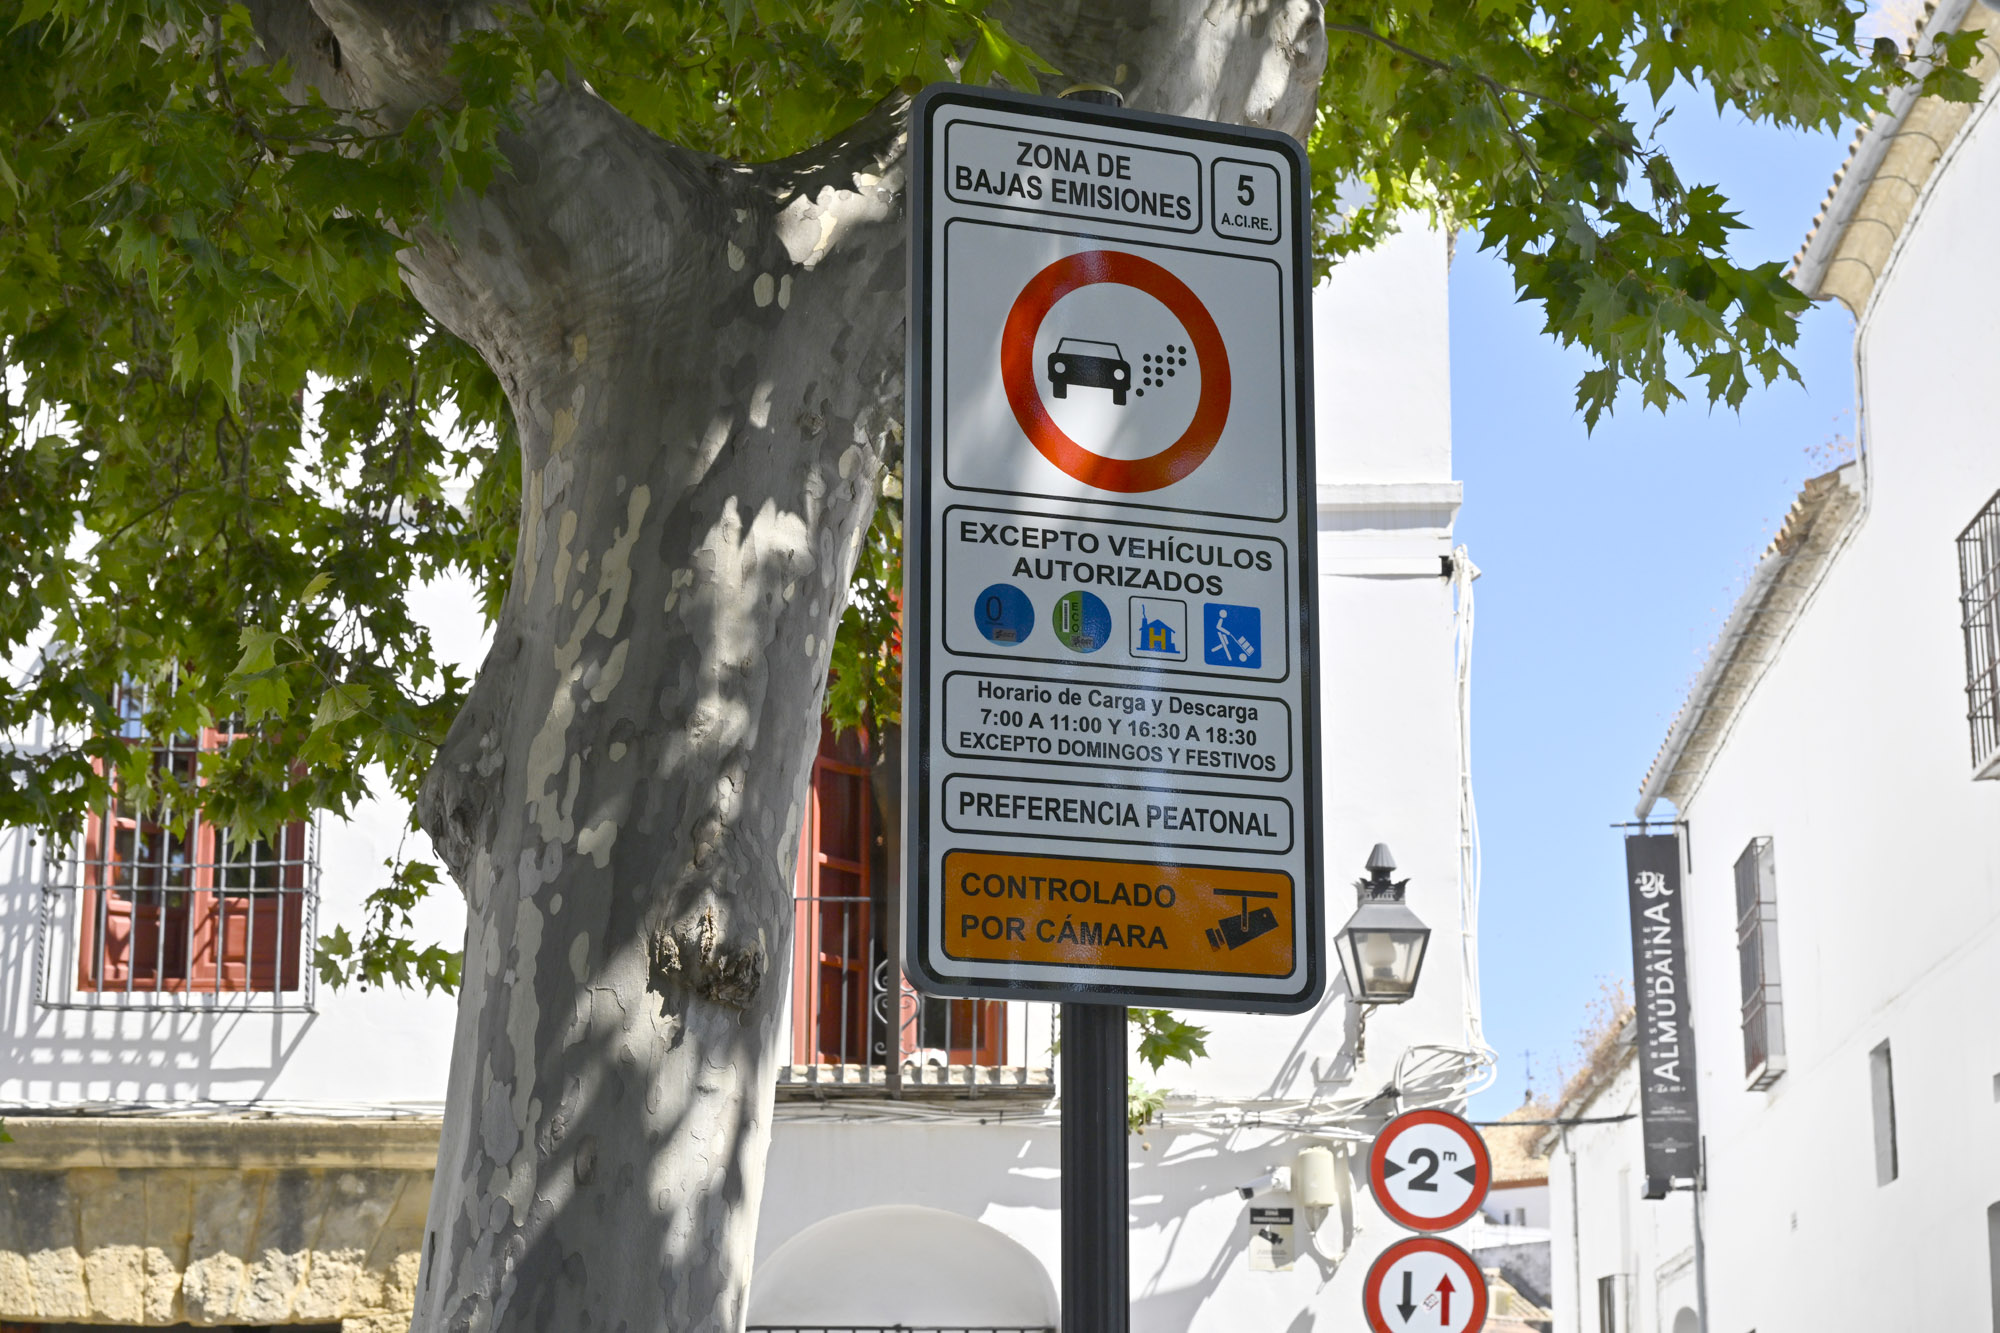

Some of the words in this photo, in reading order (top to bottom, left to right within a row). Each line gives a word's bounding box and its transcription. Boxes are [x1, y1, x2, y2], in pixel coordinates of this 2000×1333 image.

[1016, 141, 1090, 175] ZONA
[1098, 153, 1131, 180] DE
[955, 166, 1042, 200] BAJAS
[1051, 179, 1191, 220] EMISIONES
[1238, 175, 1254, 206] 5
[1221, 213, 1272, 231] A.CI.RE.
[960, 521, 1099, 553] EXCEPTO
[1108, 536, 1272, 571] VEHÍCULOS
[1012, 557, 1223, 596] AUTORIZADOS
[1071, 602, 1080, 632] ECO
[978, 681, 1052, 703] Horario
[1059, 688, 1081, 705] de
[1088, 690, 1146, 712] Carga
[1152, 699, 1163, 716] y
[1169, 696, 1258, 721] Descarga
[981, 709, 1022, 727] 7:00
[1029, 713, 1044, 728] A
[1051, 714, 1101, 733] 11:00
[1108, 719, 1121, 734] Y
[1129, 721, 1179, 739] 16:30
[1186, 725, 1200, 741] A
[1206, 727, 1256, 746] 18:30
[960, 732, 1051, 754] EXCEPTO
[1058, 739, 1162, 763] DOMINGOS
[1168, 748, 1180, 764] Y
[1186, 749, 1276, 772] FESTIVOS
[960, 792, 1139, 827] PREFERENCIA
[1147, 805, 1277, 837] PEATONAL
[961, 872, 1175, 908] CONTROLADO
[961, 915, 1025, 940] POR
[1037, 914, 1168, 949] CÁMARA
[1643, 902, 1680, 1082] ALMUDAINA
[1643, 927, 1658, 1058] RESTAURANTE
[1408, 1148, 1439, 1192] 2
[1443, 1151, 1457, 1162] m
